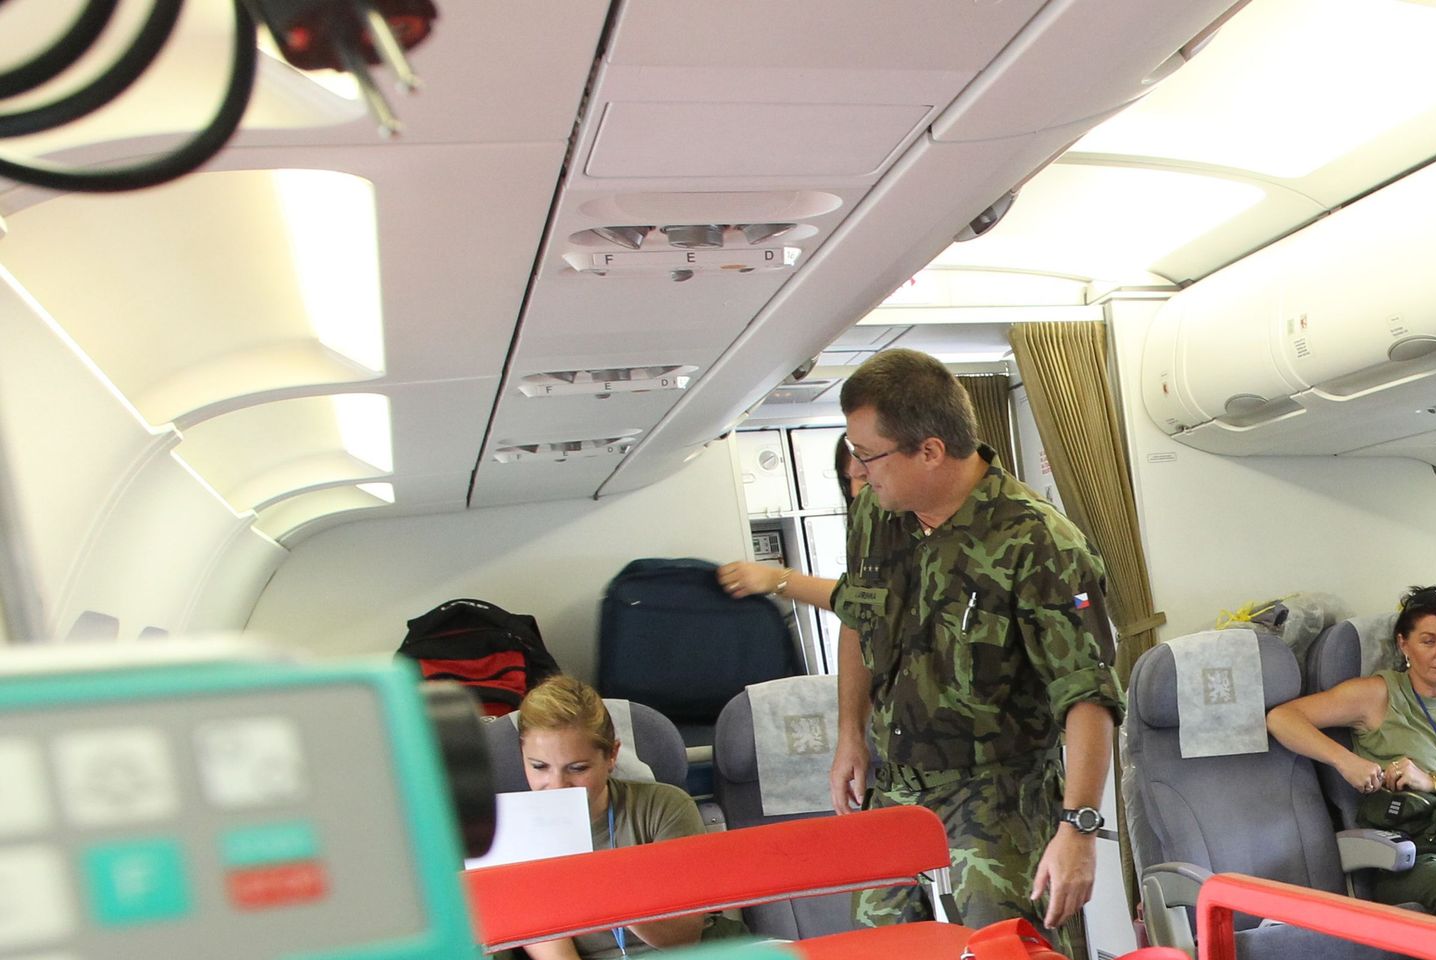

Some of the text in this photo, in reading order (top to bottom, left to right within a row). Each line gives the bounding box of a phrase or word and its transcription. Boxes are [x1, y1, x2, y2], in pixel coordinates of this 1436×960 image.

[605, 254, 614, 265] F
[687, 252, 696, 263] E
[765, 250, 774, 261] D
[545, 378, 669, 394] F E D
